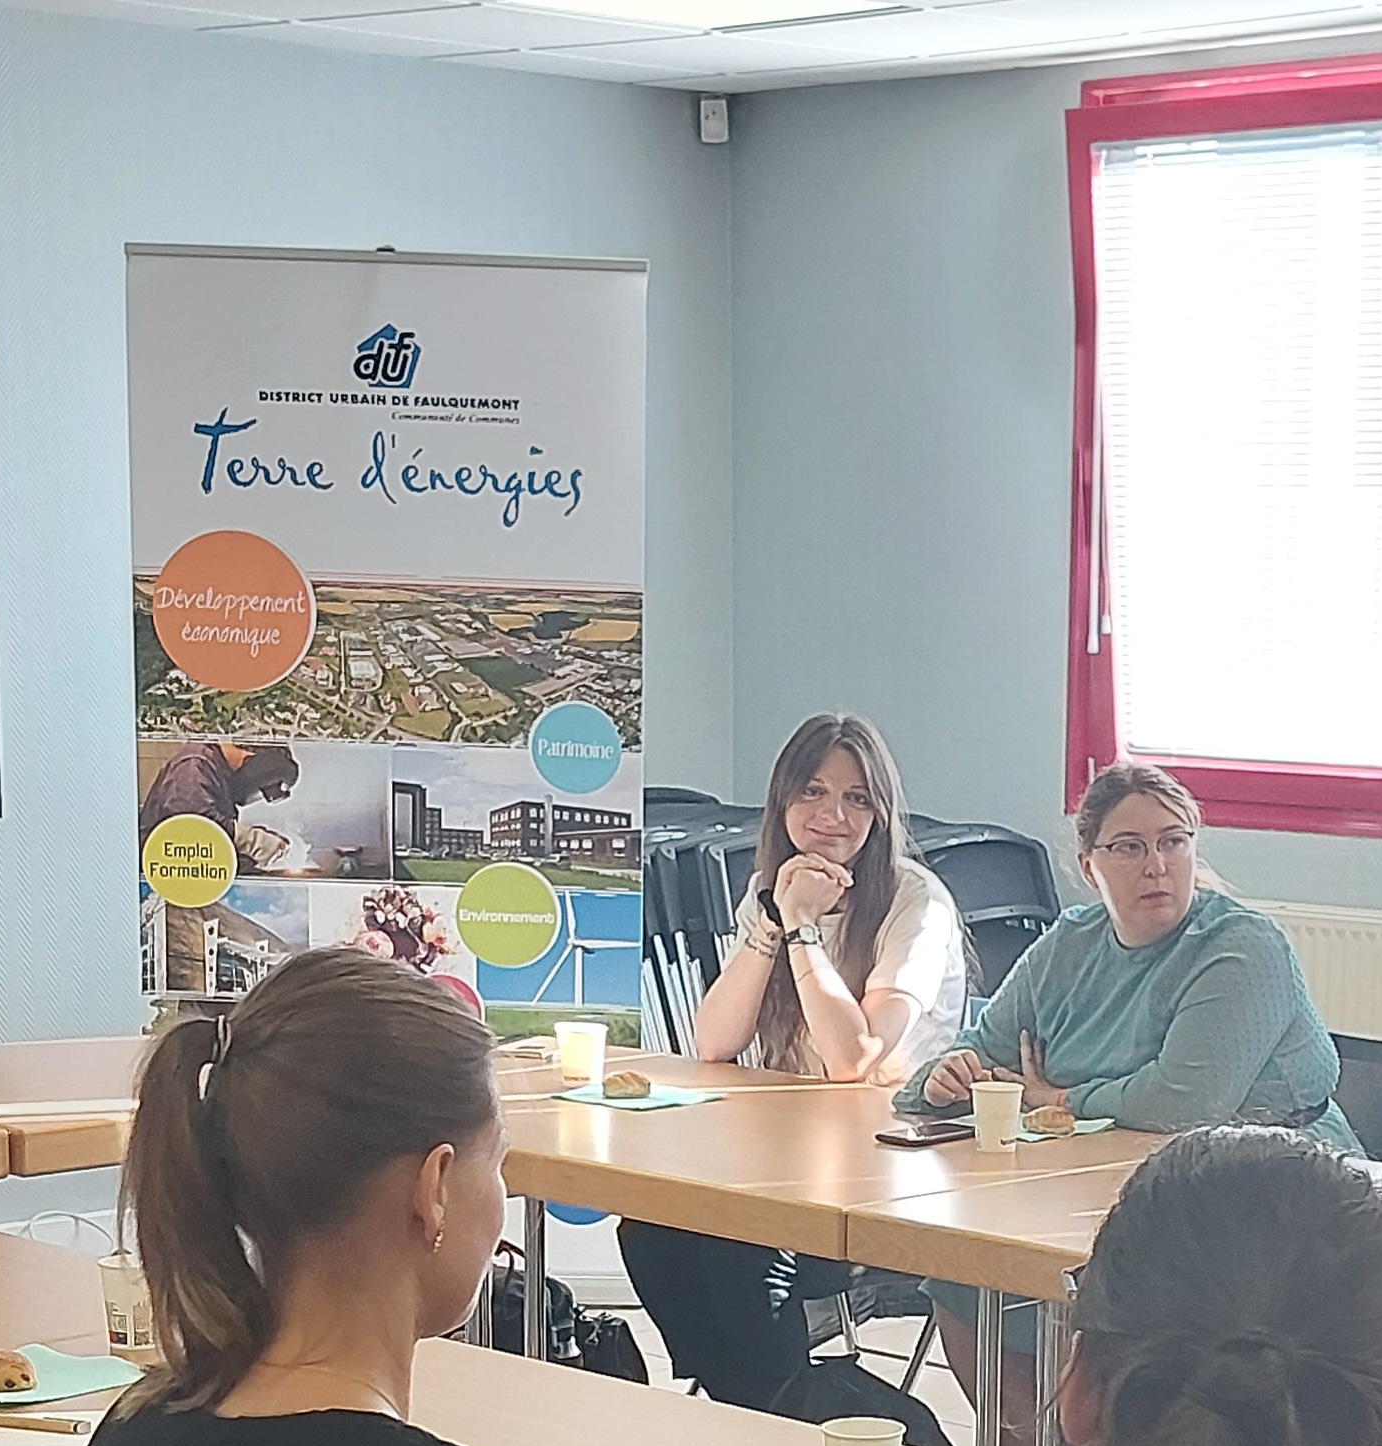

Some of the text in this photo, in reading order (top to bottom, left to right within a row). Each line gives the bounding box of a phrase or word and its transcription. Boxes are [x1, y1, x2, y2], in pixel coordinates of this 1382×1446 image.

[258, 390, 520, 411] DISTRICT URBAIN DE FAULQUEMONT
[455, 412, 466, 423] de
[469, 414, 520, 425] Communes
[193, 406, 584, 528] Terre d'énergies
[155, 586, 307, 620] Développement
[181, 622, 281, 658] économique
[537, 738, 615, 760] Patrimoine
[164, 841, 213, 863] Emploi
[149, 862, 228, 880] Formation
[458, 908, 555, 924] Environnement
